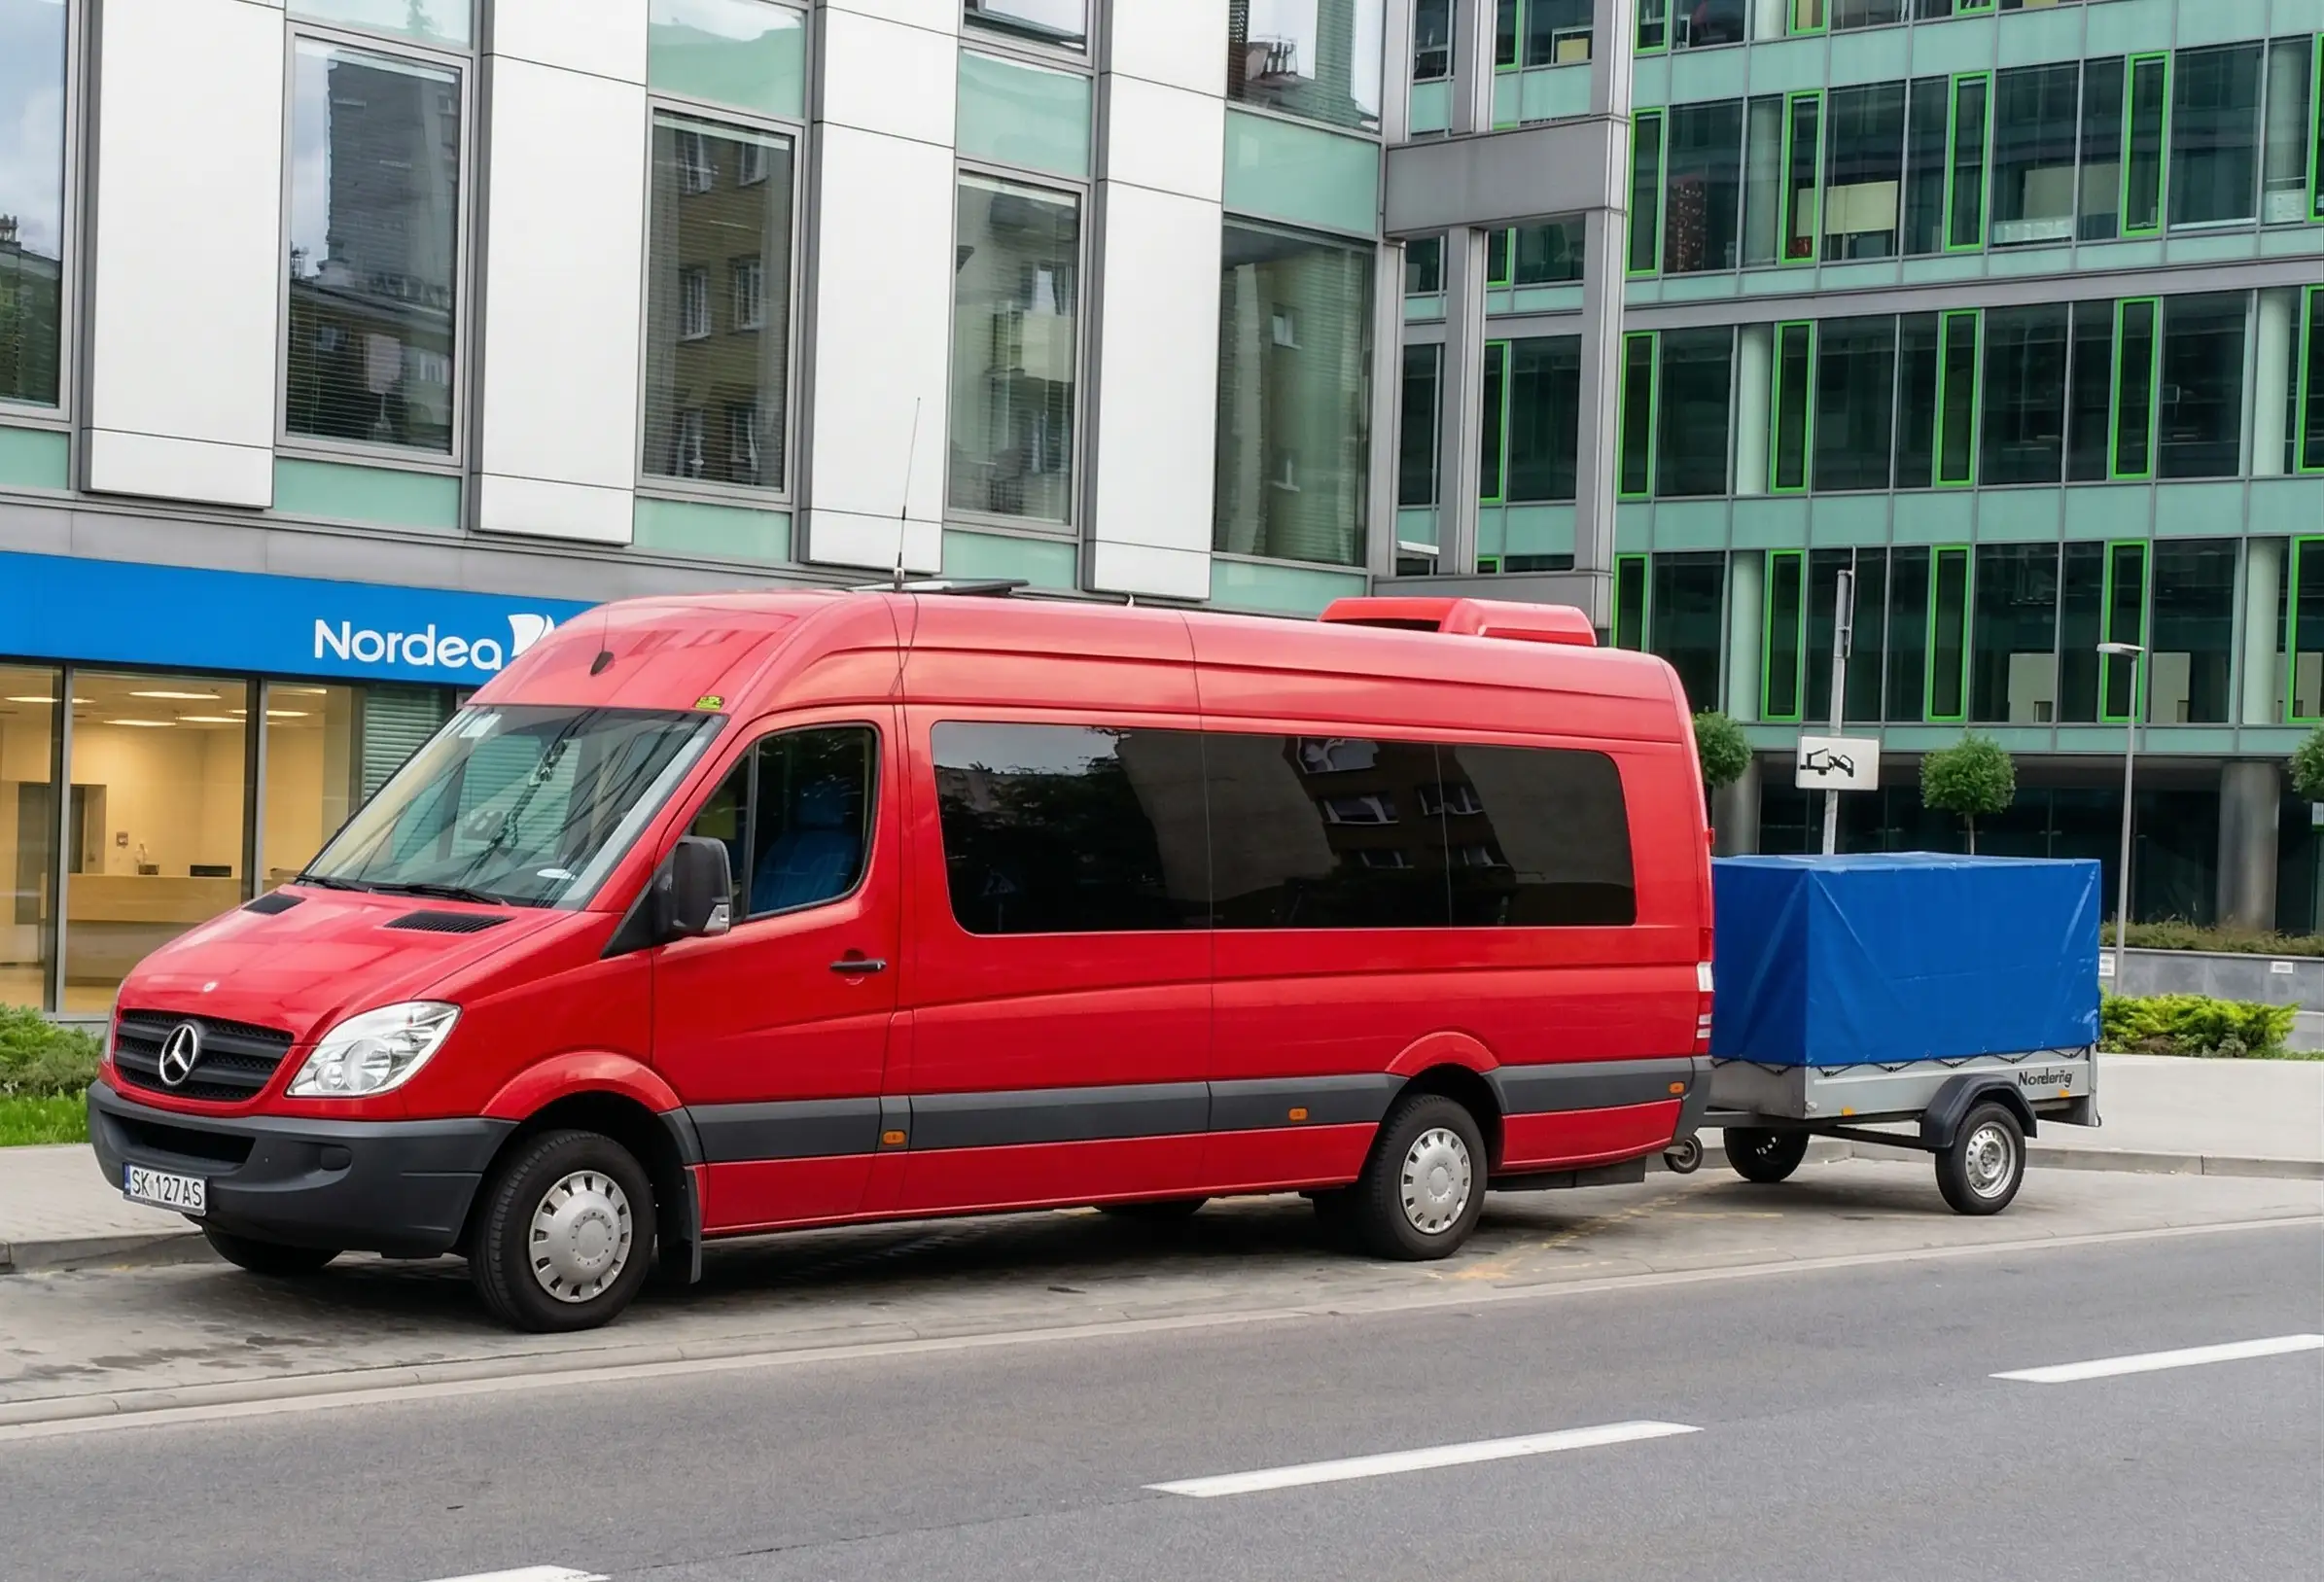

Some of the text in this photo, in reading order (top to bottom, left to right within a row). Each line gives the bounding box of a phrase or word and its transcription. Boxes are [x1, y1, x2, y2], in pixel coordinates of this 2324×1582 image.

[314, 618, 502, 670] Nordea
[132, 1169, 202, 1207] SK 127AS
